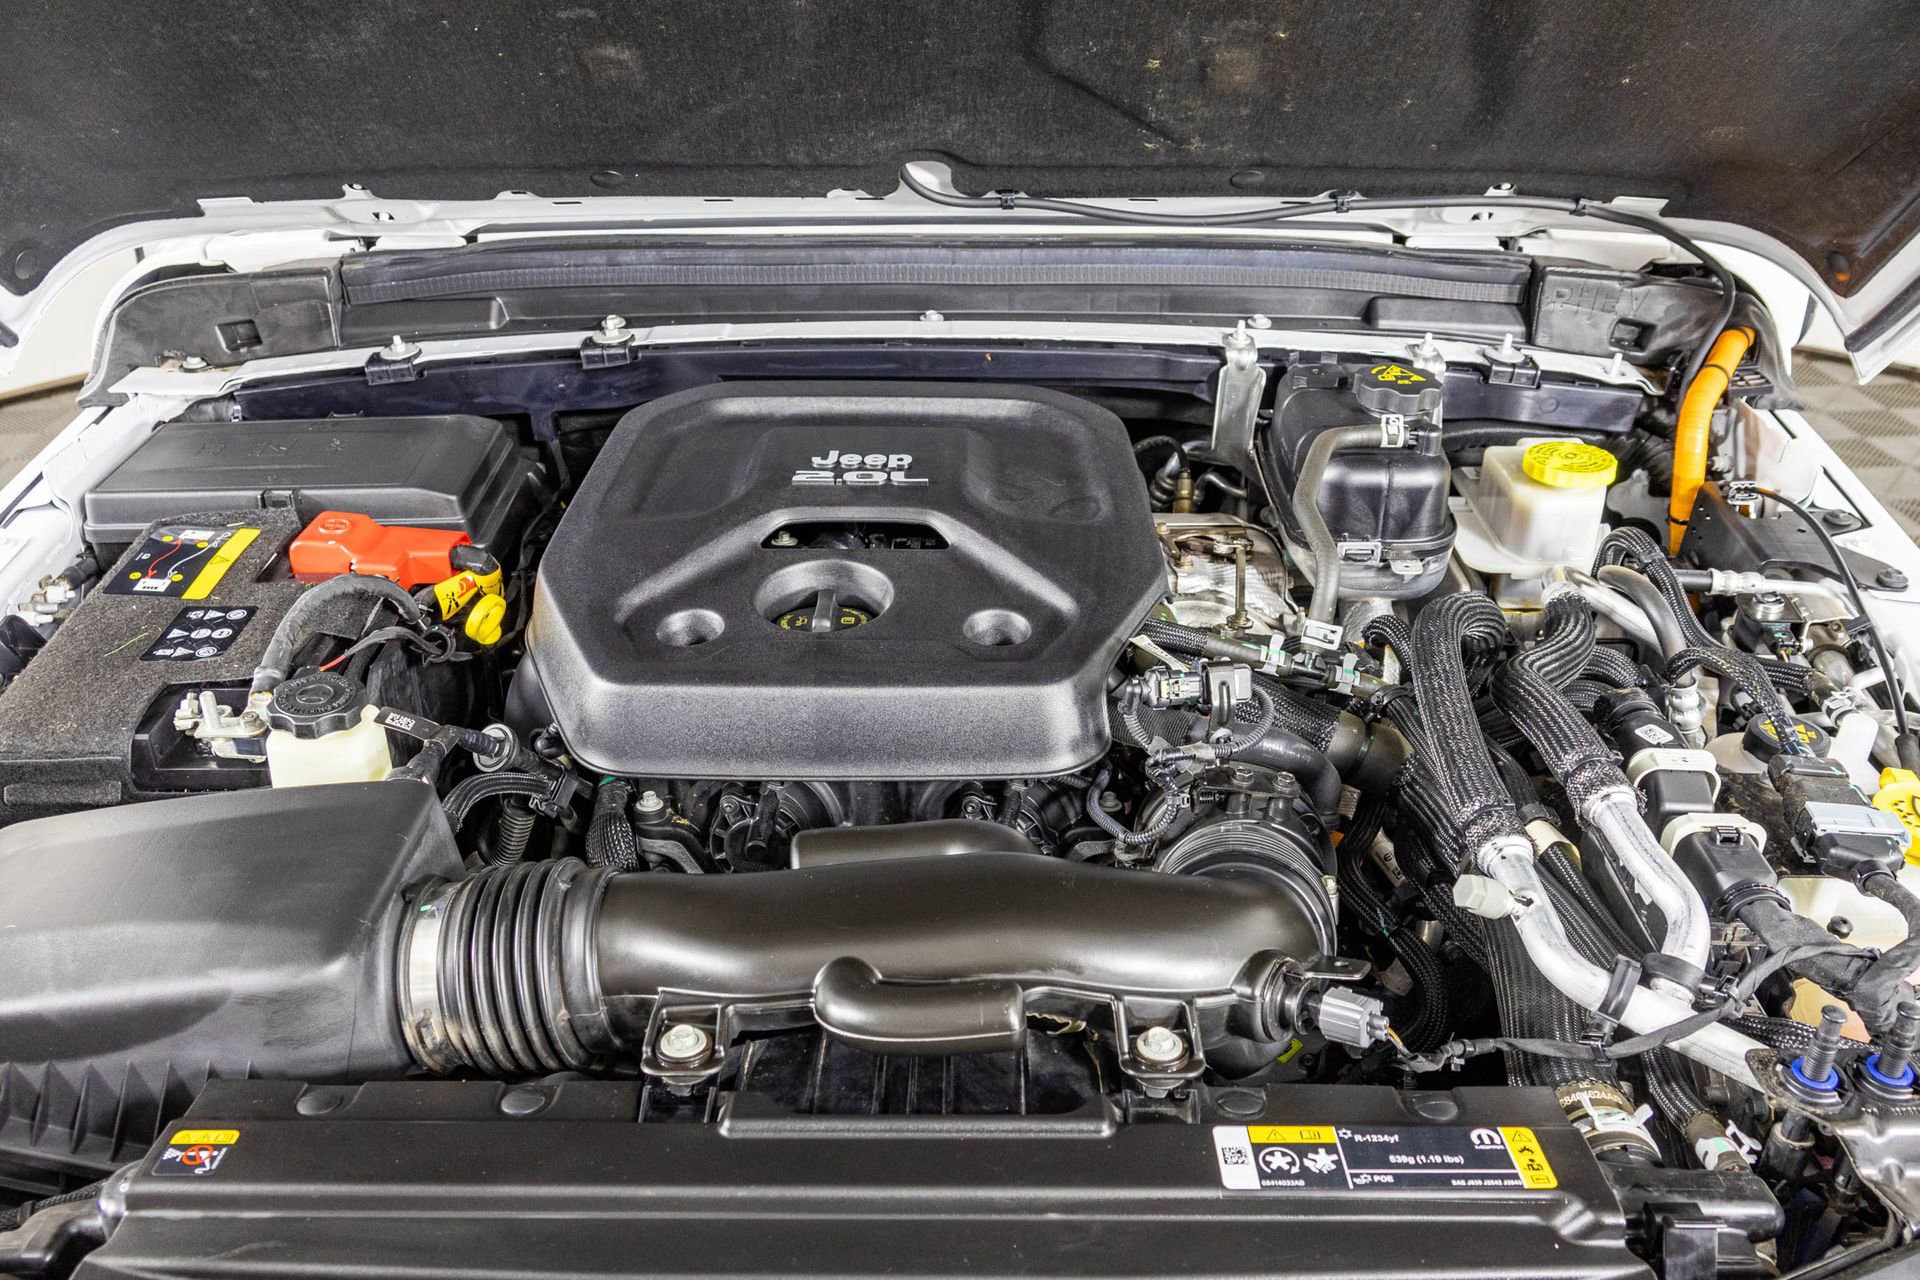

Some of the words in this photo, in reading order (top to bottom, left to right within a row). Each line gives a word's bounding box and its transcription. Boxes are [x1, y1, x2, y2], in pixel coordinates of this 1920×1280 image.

[811, 450, 913, 471] Jeep
[791, 470, 929, 486] 2.0L
[1354, 1134, 1400, 1144] R-1234yf
[1373, 1174, 1395, 1183] POE
